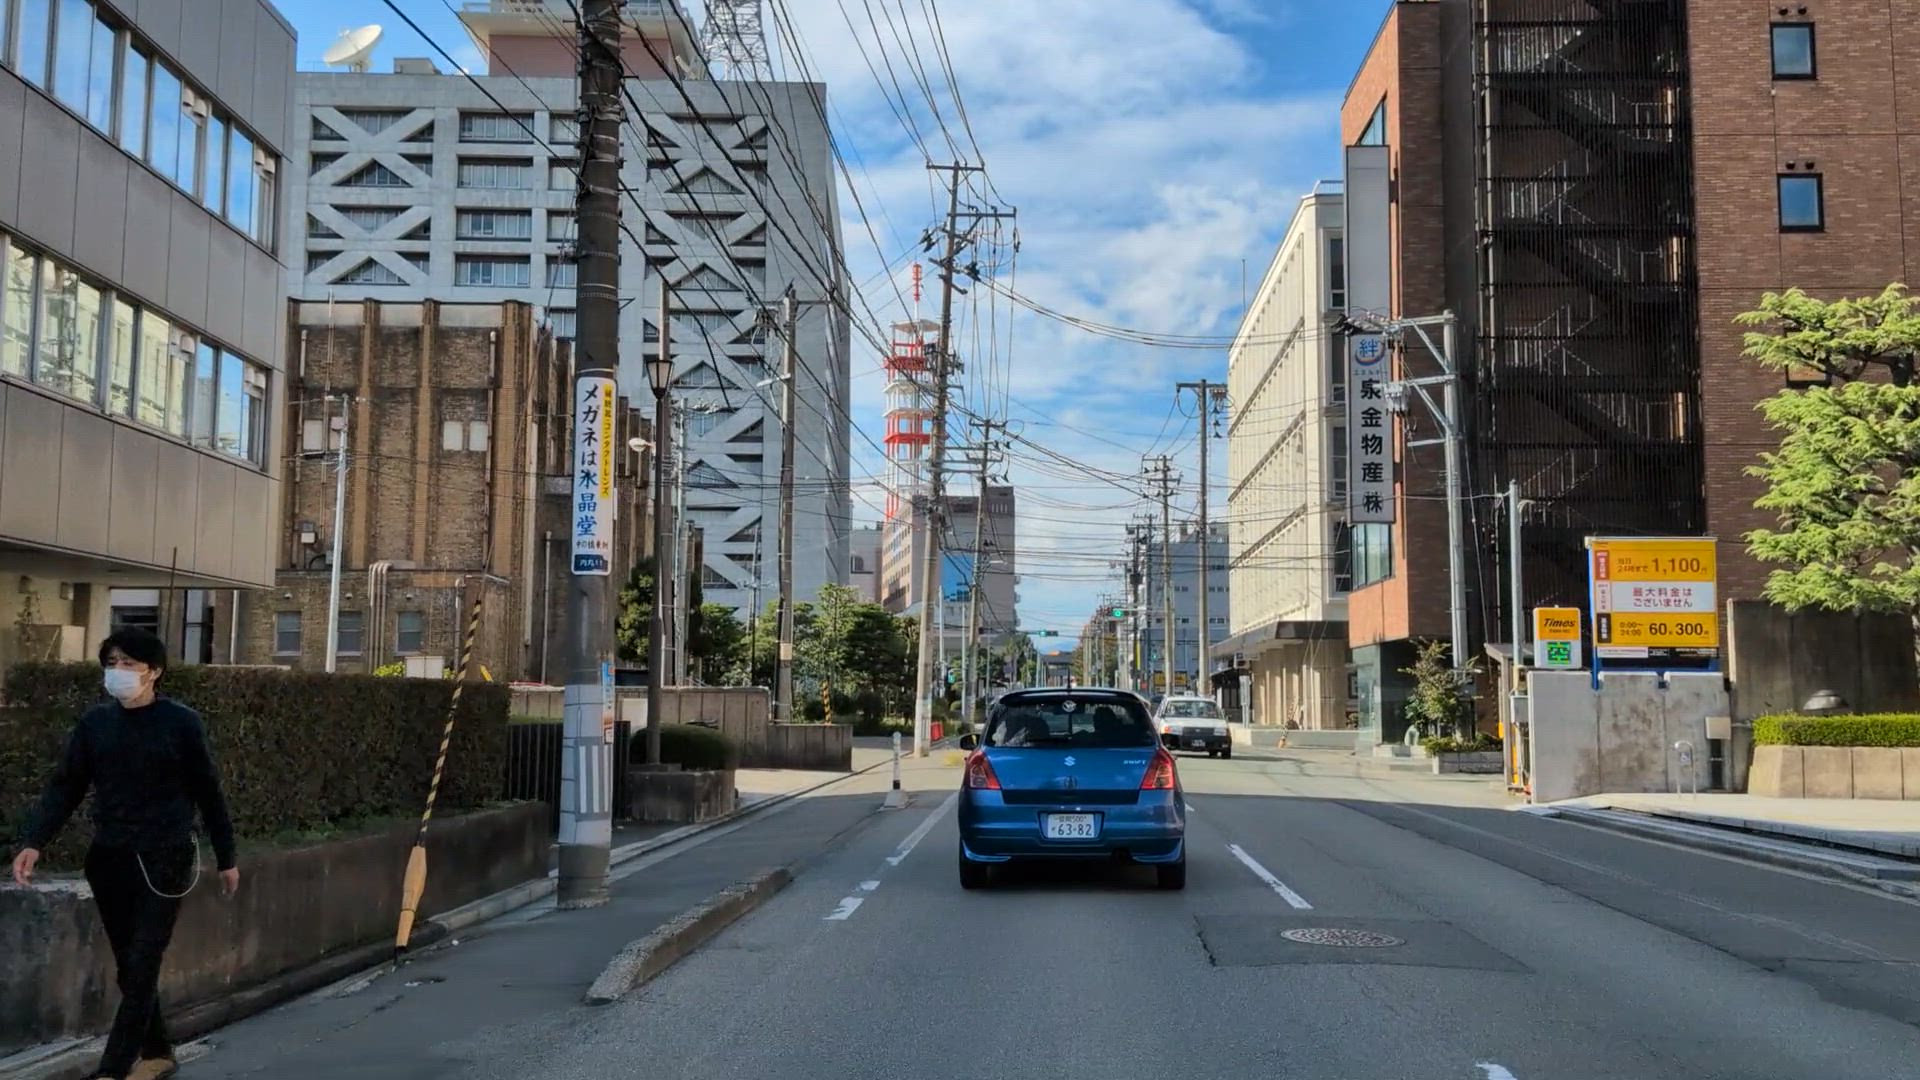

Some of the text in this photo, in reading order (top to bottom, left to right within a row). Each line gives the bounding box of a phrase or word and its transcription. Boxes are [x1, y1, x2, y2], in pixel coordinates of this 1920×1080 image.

[1633, 588, 1692, 597] 最大料金は
[1633, 599, 1693, 608] ございません
[1544, 618, 1576, 627] Times
